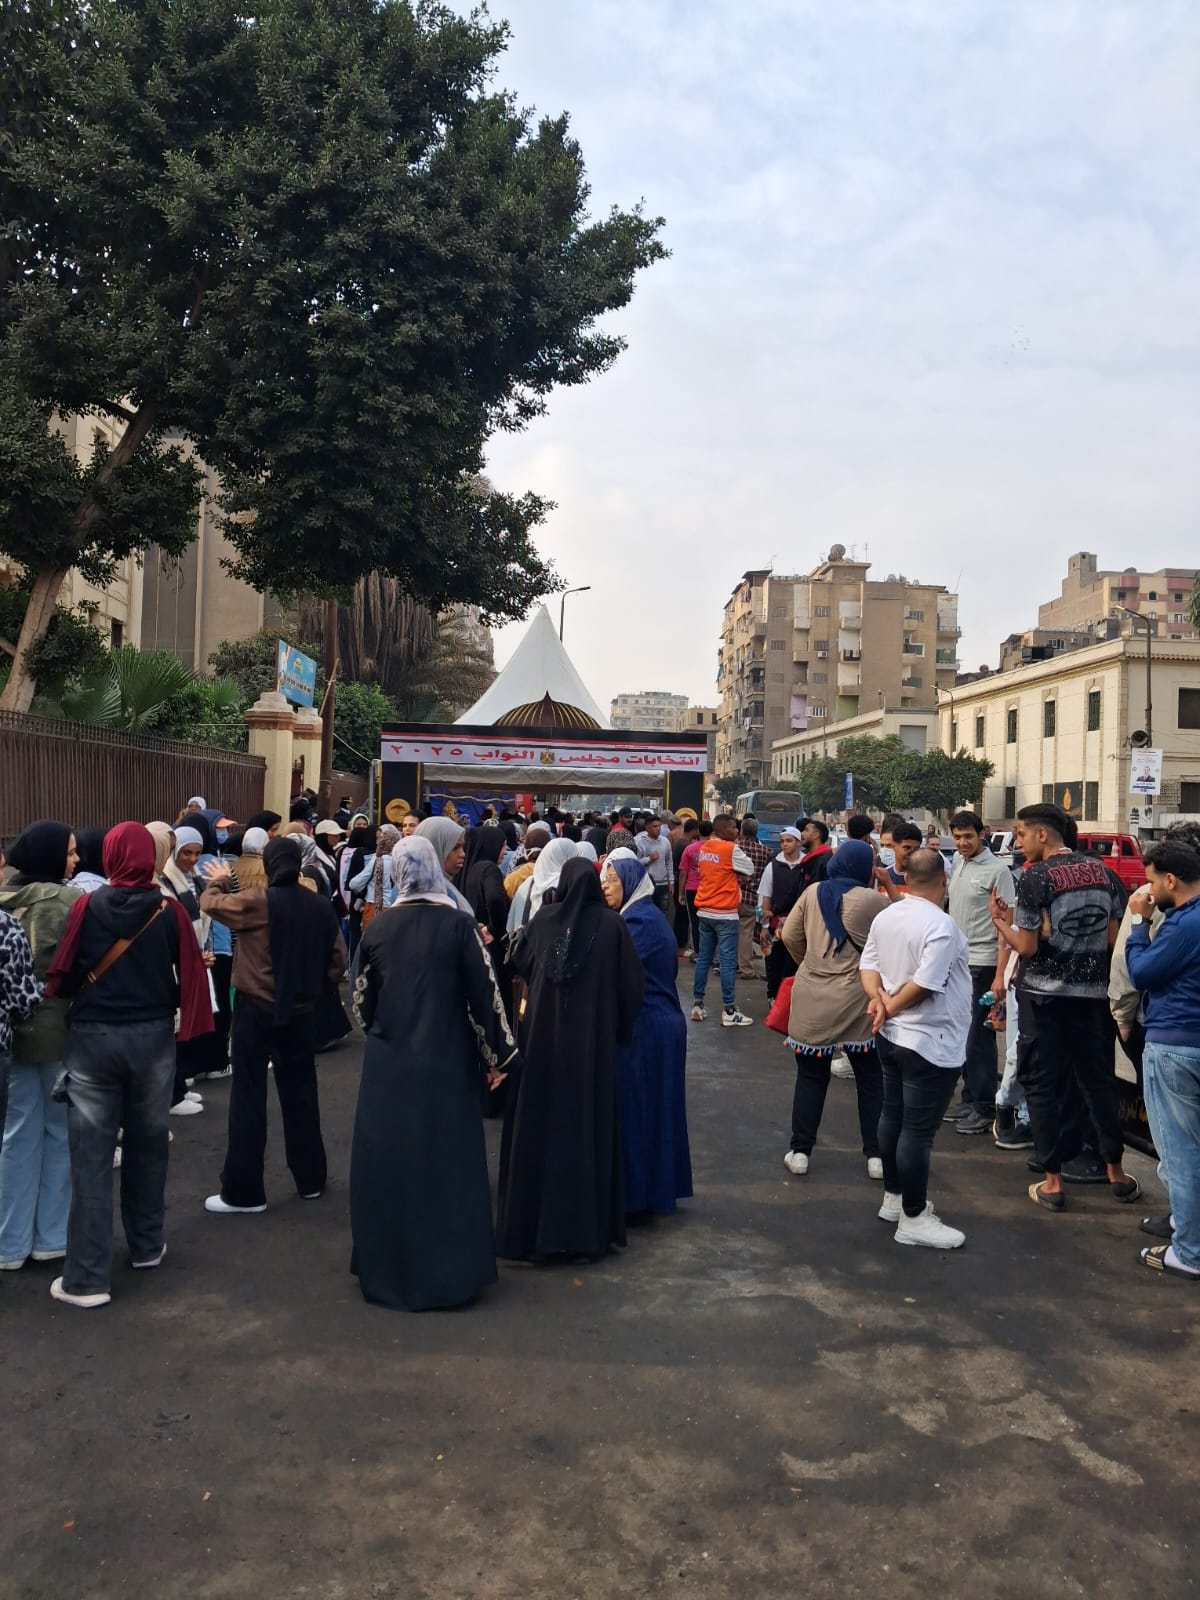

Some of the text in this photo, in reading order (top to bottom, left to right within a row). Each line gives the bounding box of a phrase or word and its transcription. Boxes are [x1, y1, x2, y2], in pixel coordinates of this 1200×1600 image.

[473, 750, 534, 761] النواب
[559, 753, 620, 765] مجلس
[626, 755, 700, 766] انتخابات
